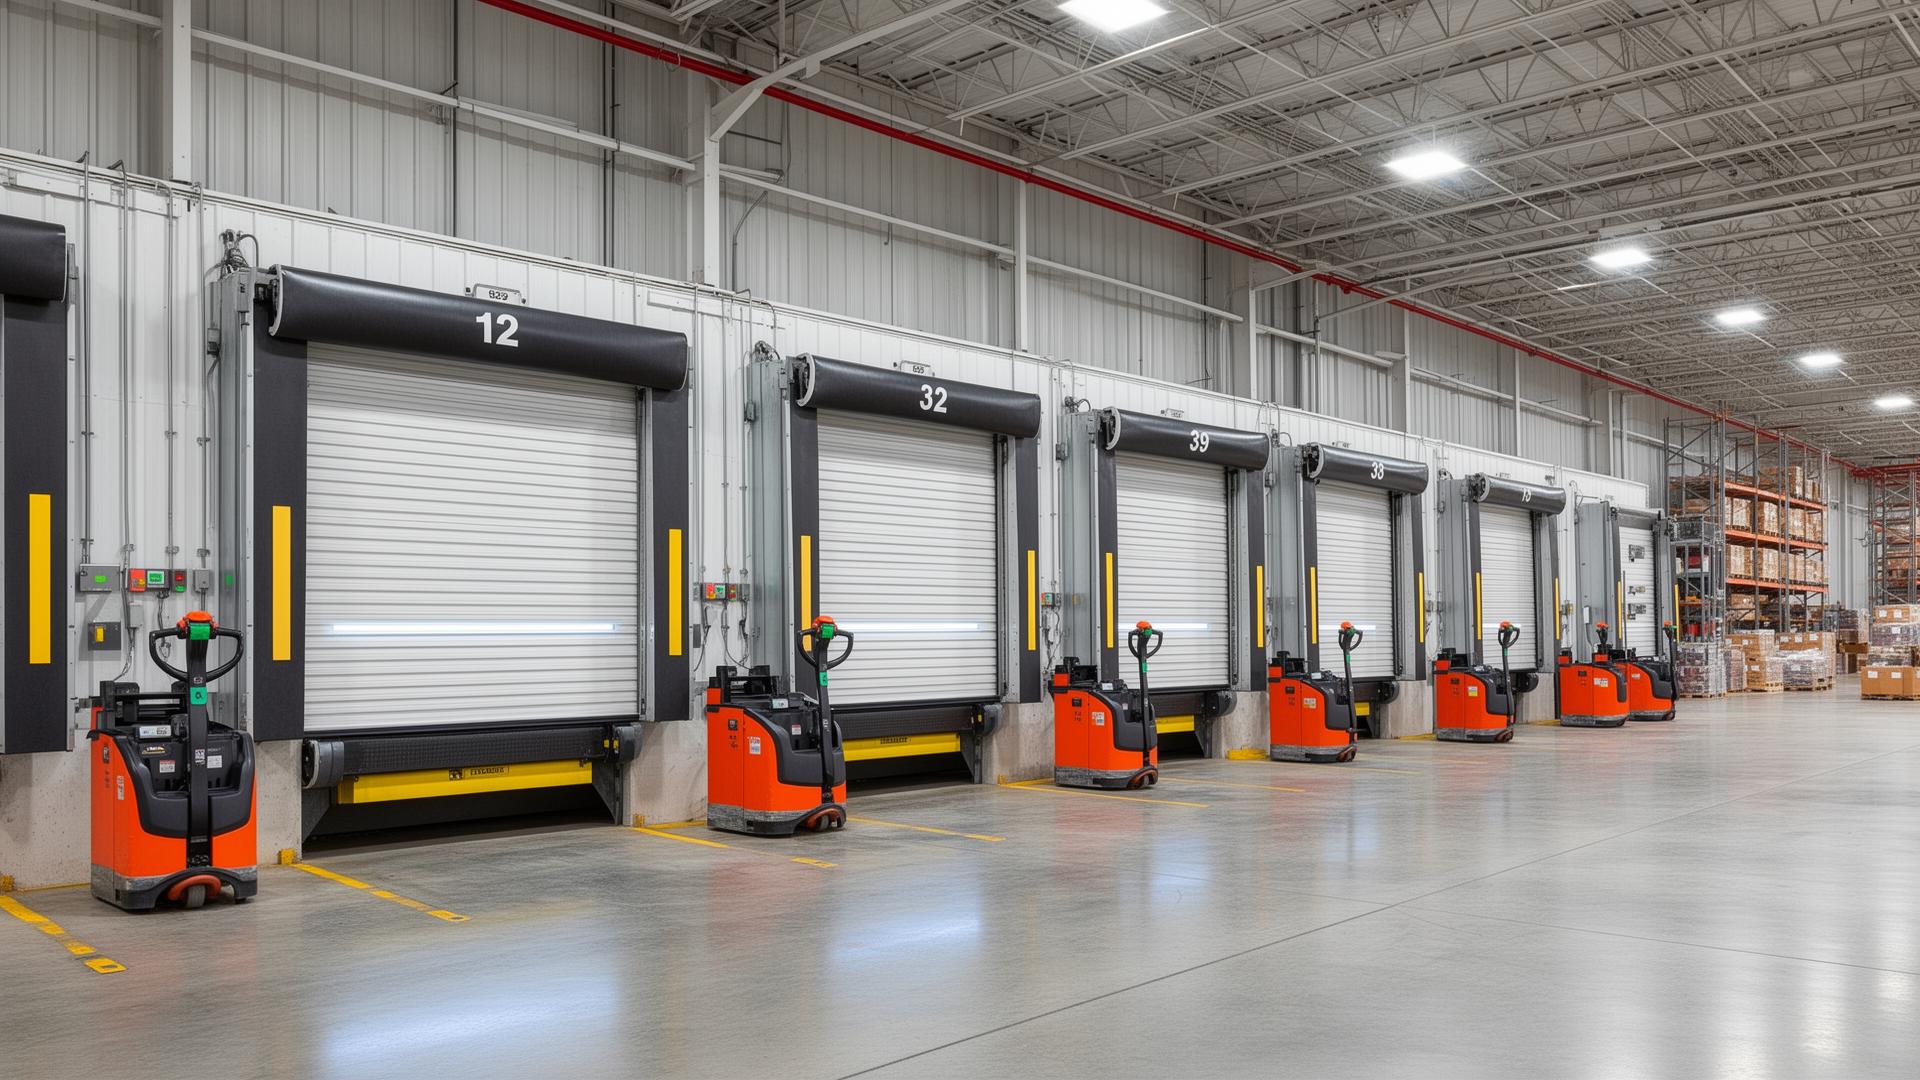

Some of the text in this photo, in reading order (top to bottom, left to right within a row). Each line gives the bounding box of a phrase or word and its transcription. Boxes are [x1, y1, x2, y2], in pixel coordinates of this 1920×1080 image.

[476, 312, 519, 347] 12
[920, 384, 948, 413] 32
[1189, 430, 1209, 453] 39
